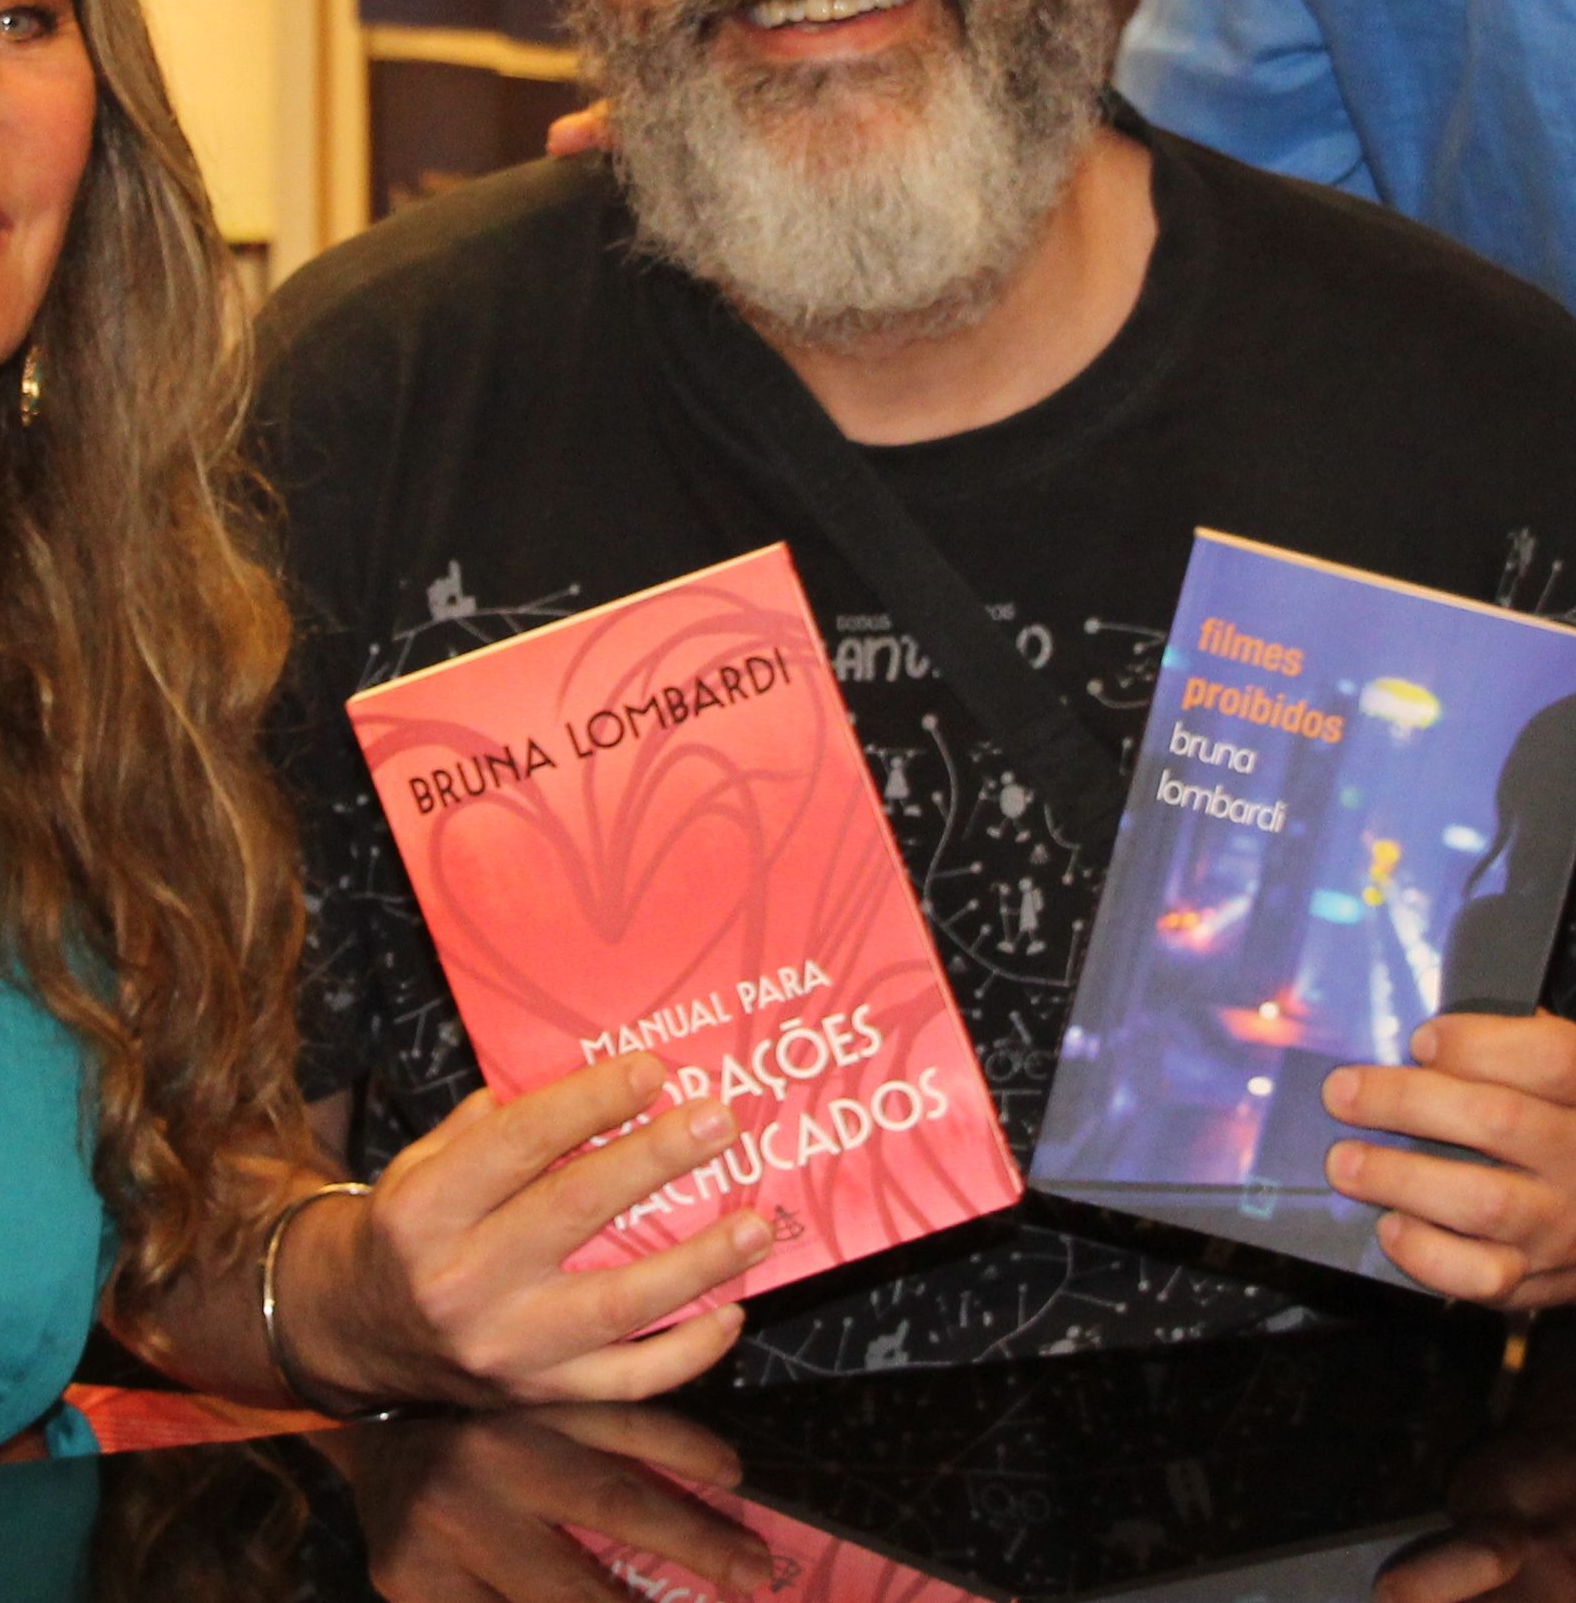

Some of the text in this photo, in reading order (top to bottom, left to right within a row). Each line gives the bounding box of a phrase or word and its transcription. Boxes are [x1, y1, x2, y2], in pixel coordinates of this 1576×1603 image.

[1198, 617, 1305, 677] filmes
[409, 647, 793, 815] BRUNA LOMBARDI
[1181, 674, 1346, 744] proibidos
[1168, 722, 1257, 775] bruna
[1156, 770, 1286, 833] lombardi
[580, 959, 831, 1066] MANUAL PARA
[589, 1004, 882, 1146] RAÇÕES
